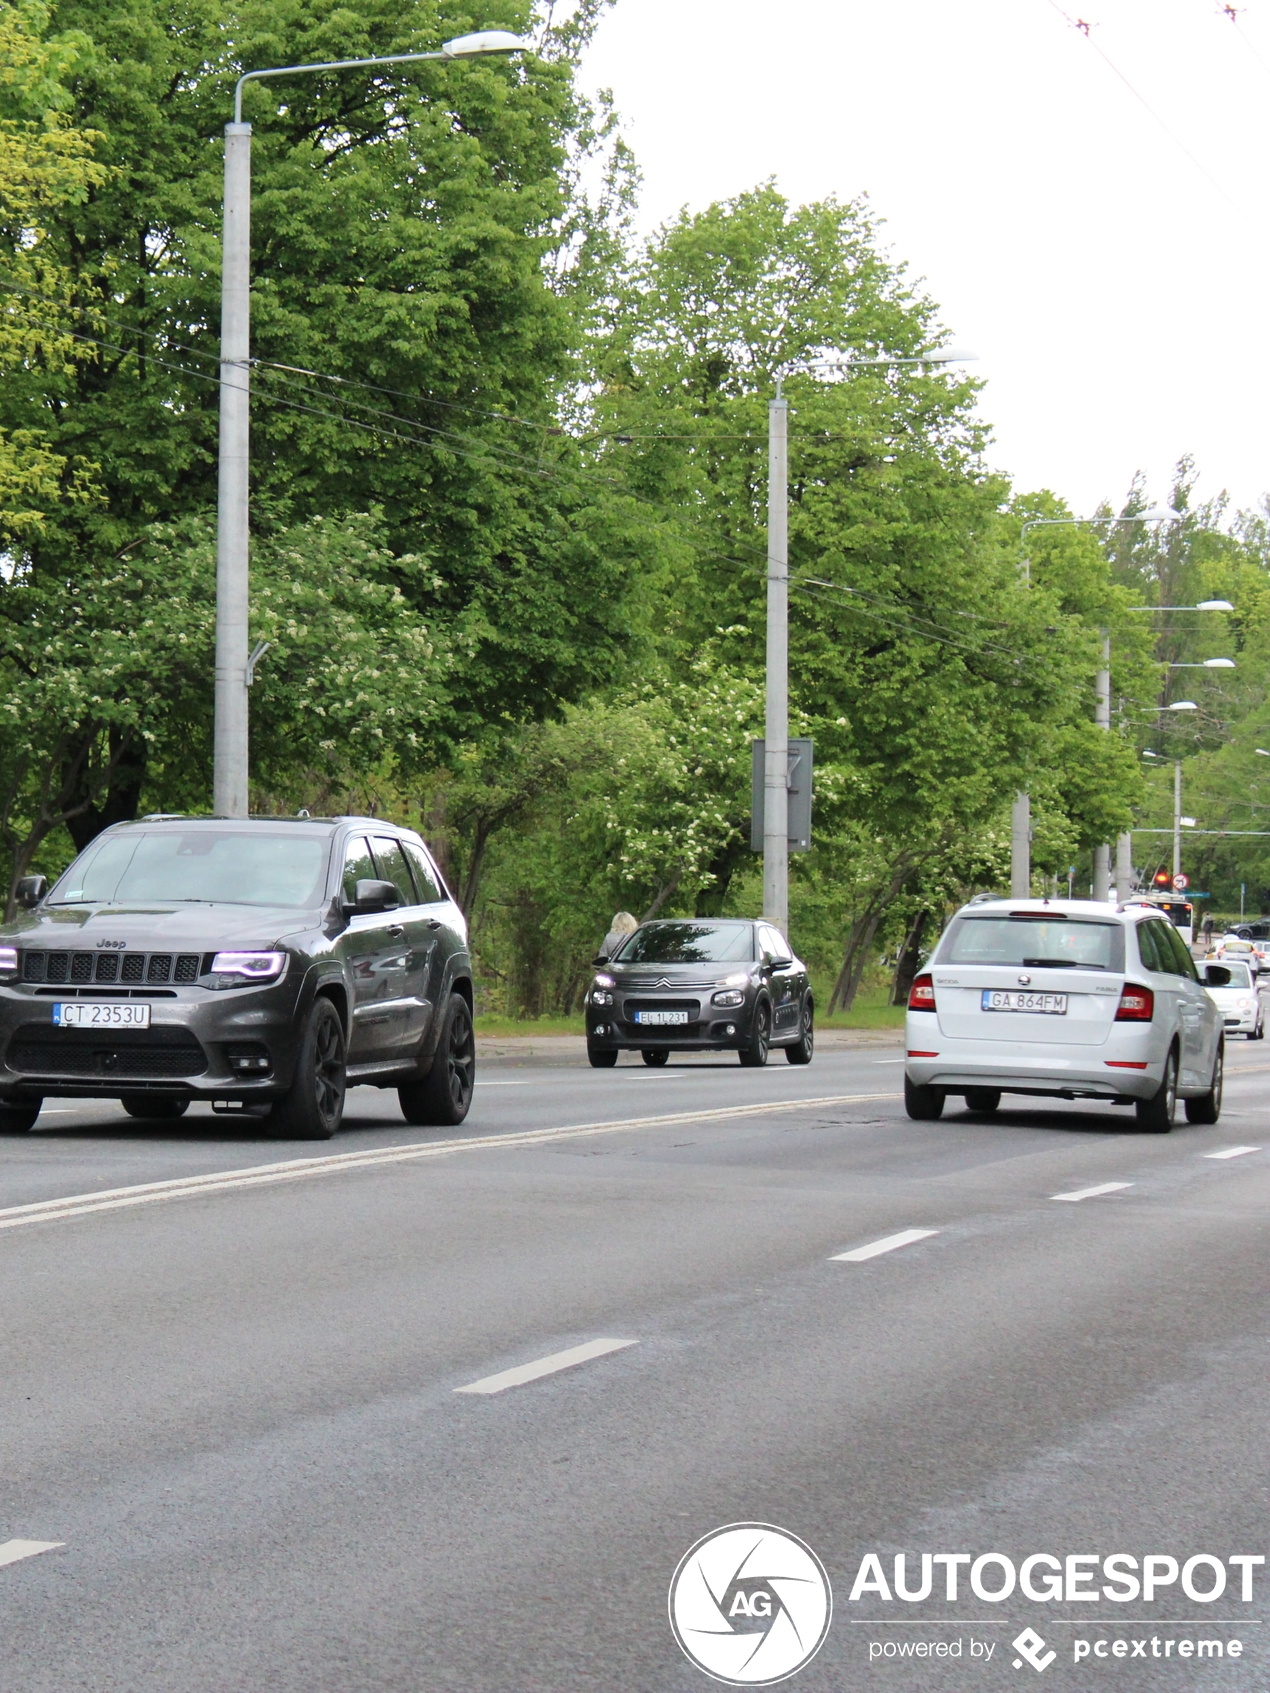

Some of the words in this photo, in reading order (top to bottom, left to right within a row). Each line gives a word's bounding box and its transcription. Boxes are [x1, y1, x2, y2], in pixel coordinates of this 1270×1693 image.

[96, 939, 126, 949] Jeep
[992, 993, 1010, 1007] GA
[1017, 994, 1063, 1010] 864FM
[64, 1006, 85, 1022] CT
[91, 1006, 145, 1023] 2353U
